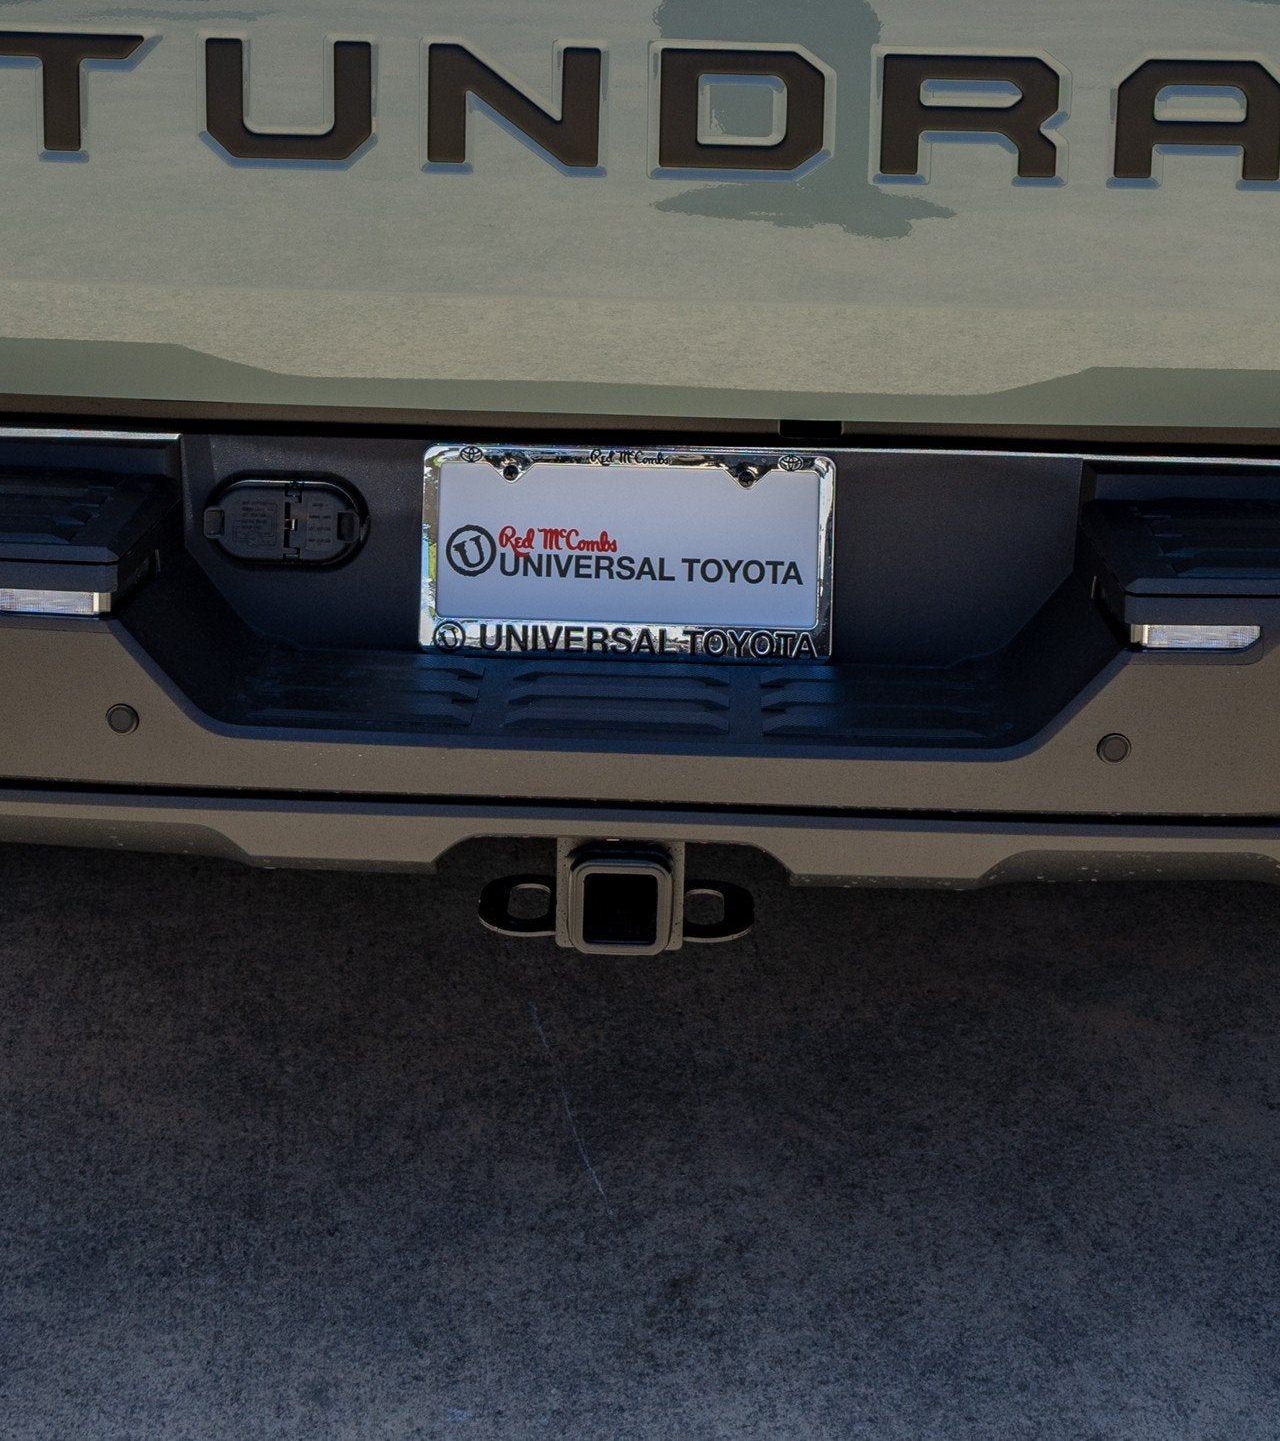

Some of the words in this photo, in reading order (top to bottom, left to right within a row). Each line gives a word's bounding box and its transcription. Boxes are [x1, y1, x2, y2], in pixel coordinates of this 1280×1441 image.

[589, 448, 615, 466] Red
[616, 449, 669, 465] McCombs
[498, 525, 535, 558] Red
[538, 528, 618, 553] McCombs
[499, 552, 676, 581] UNIVERSAL
[681, 558, 804, 585] TOYOTA
[479, 623, 678, 655] UNIVERSAL
[683, 628, 818, 658] TOYOTA
